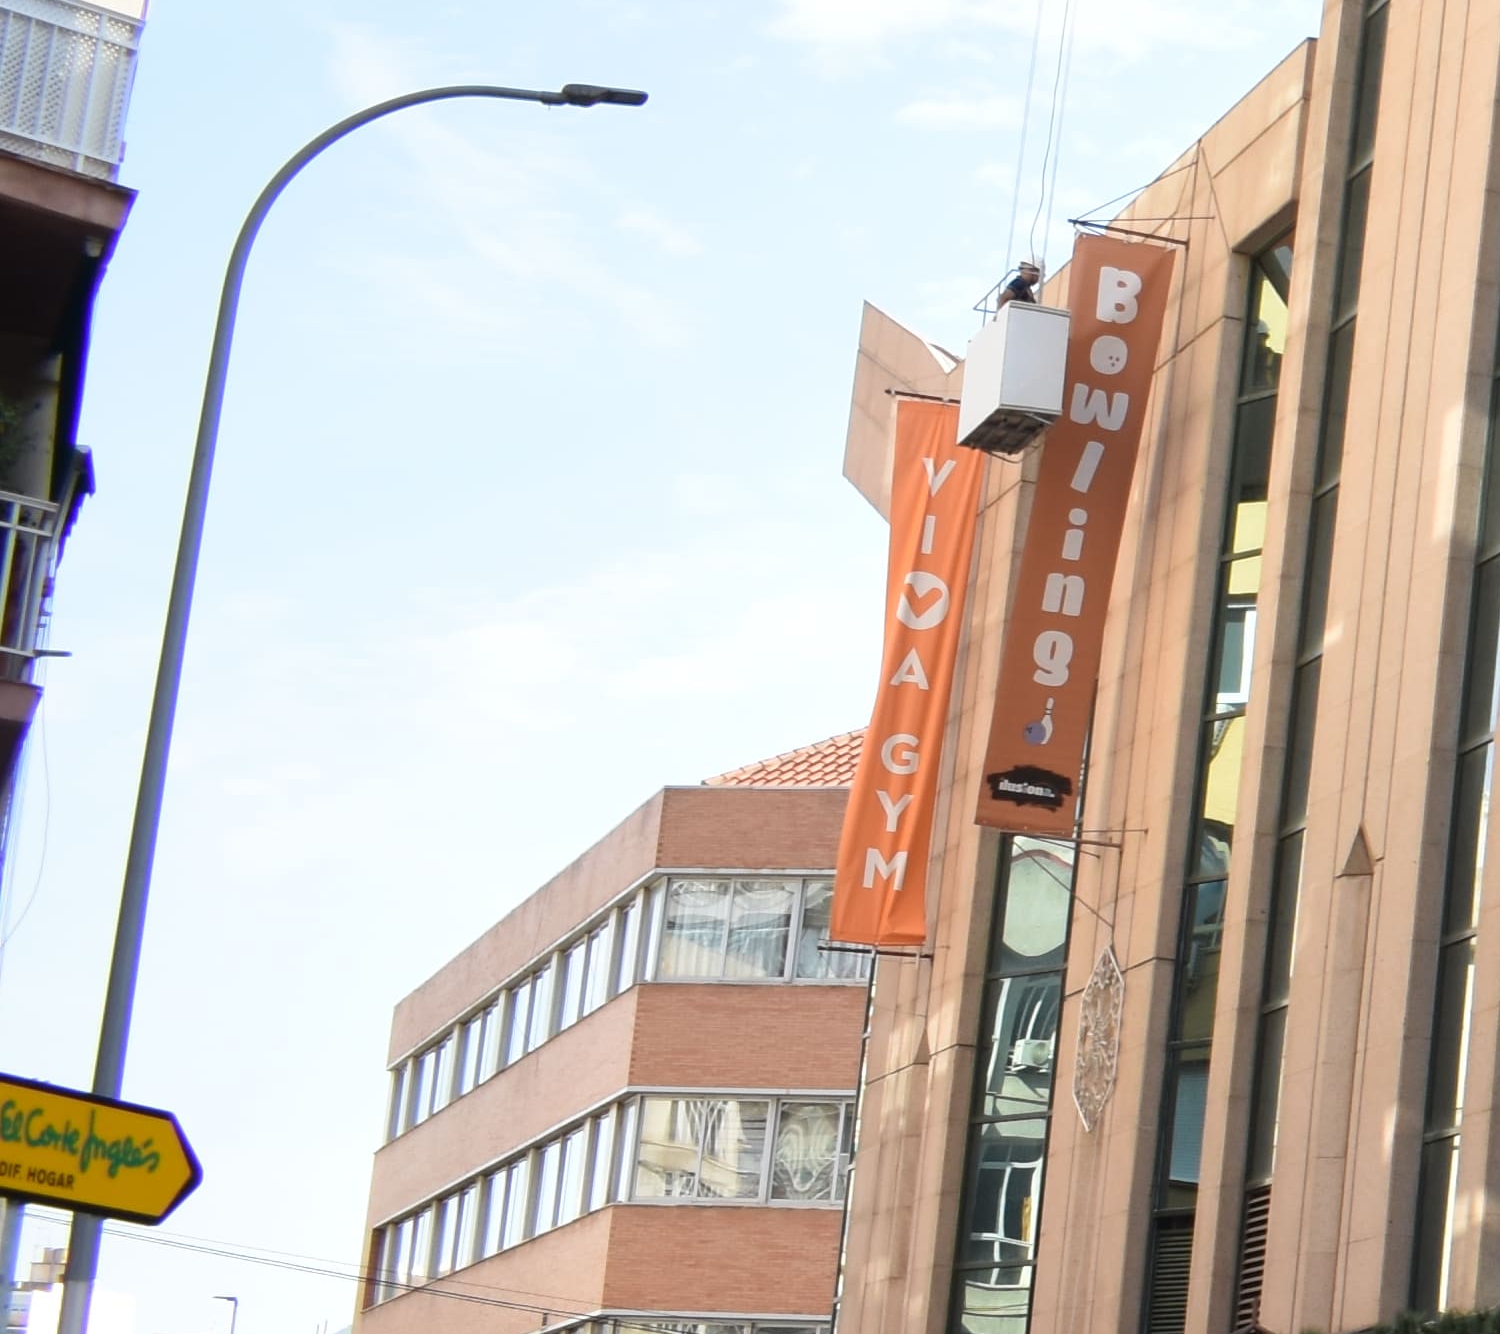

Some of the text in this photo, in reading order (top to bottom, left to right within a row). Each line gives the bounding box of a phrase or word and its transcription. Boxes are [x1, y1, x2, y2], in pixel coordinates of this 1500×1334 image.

[863, 734, 920, 891] GYM
[1, 1100, 23, 1142] El
[25, 1108, 80, 1154] Corte
[27, 1167, 75, 1189] HOGAR
